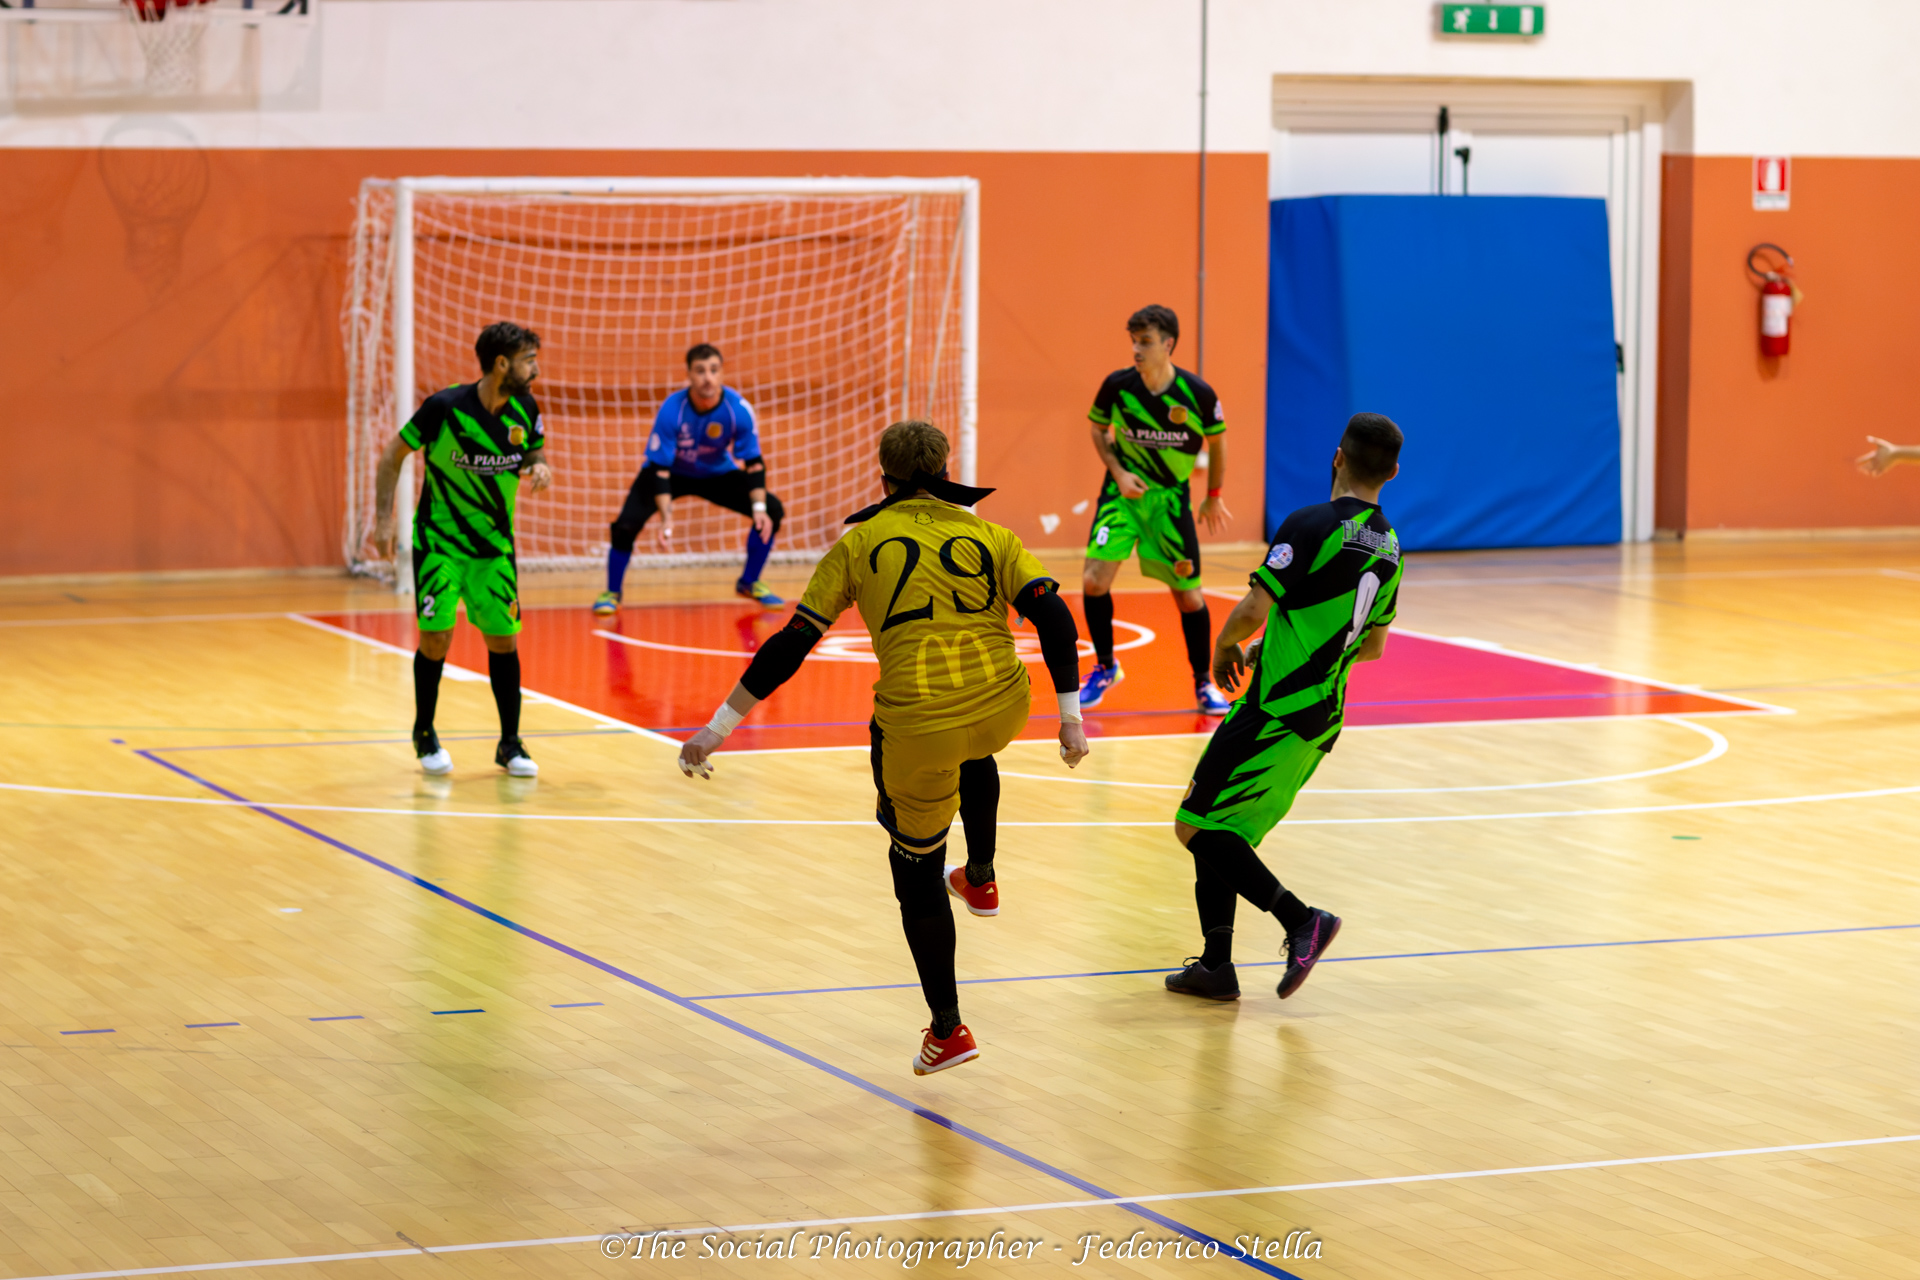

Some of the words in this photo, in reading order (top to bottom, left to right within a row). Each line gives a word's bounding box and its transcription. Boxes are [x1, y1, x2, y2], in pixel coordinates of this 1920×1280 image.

[1136, 429, 1189, 442] PIADINA
[451, 450, 470, 464] LA
[1096, 526, 1110, 546] 6
[869, 536, 997, 632] 29
[423, 595, 435, 617] 2
[1344, 571, 1381, 651] 9
